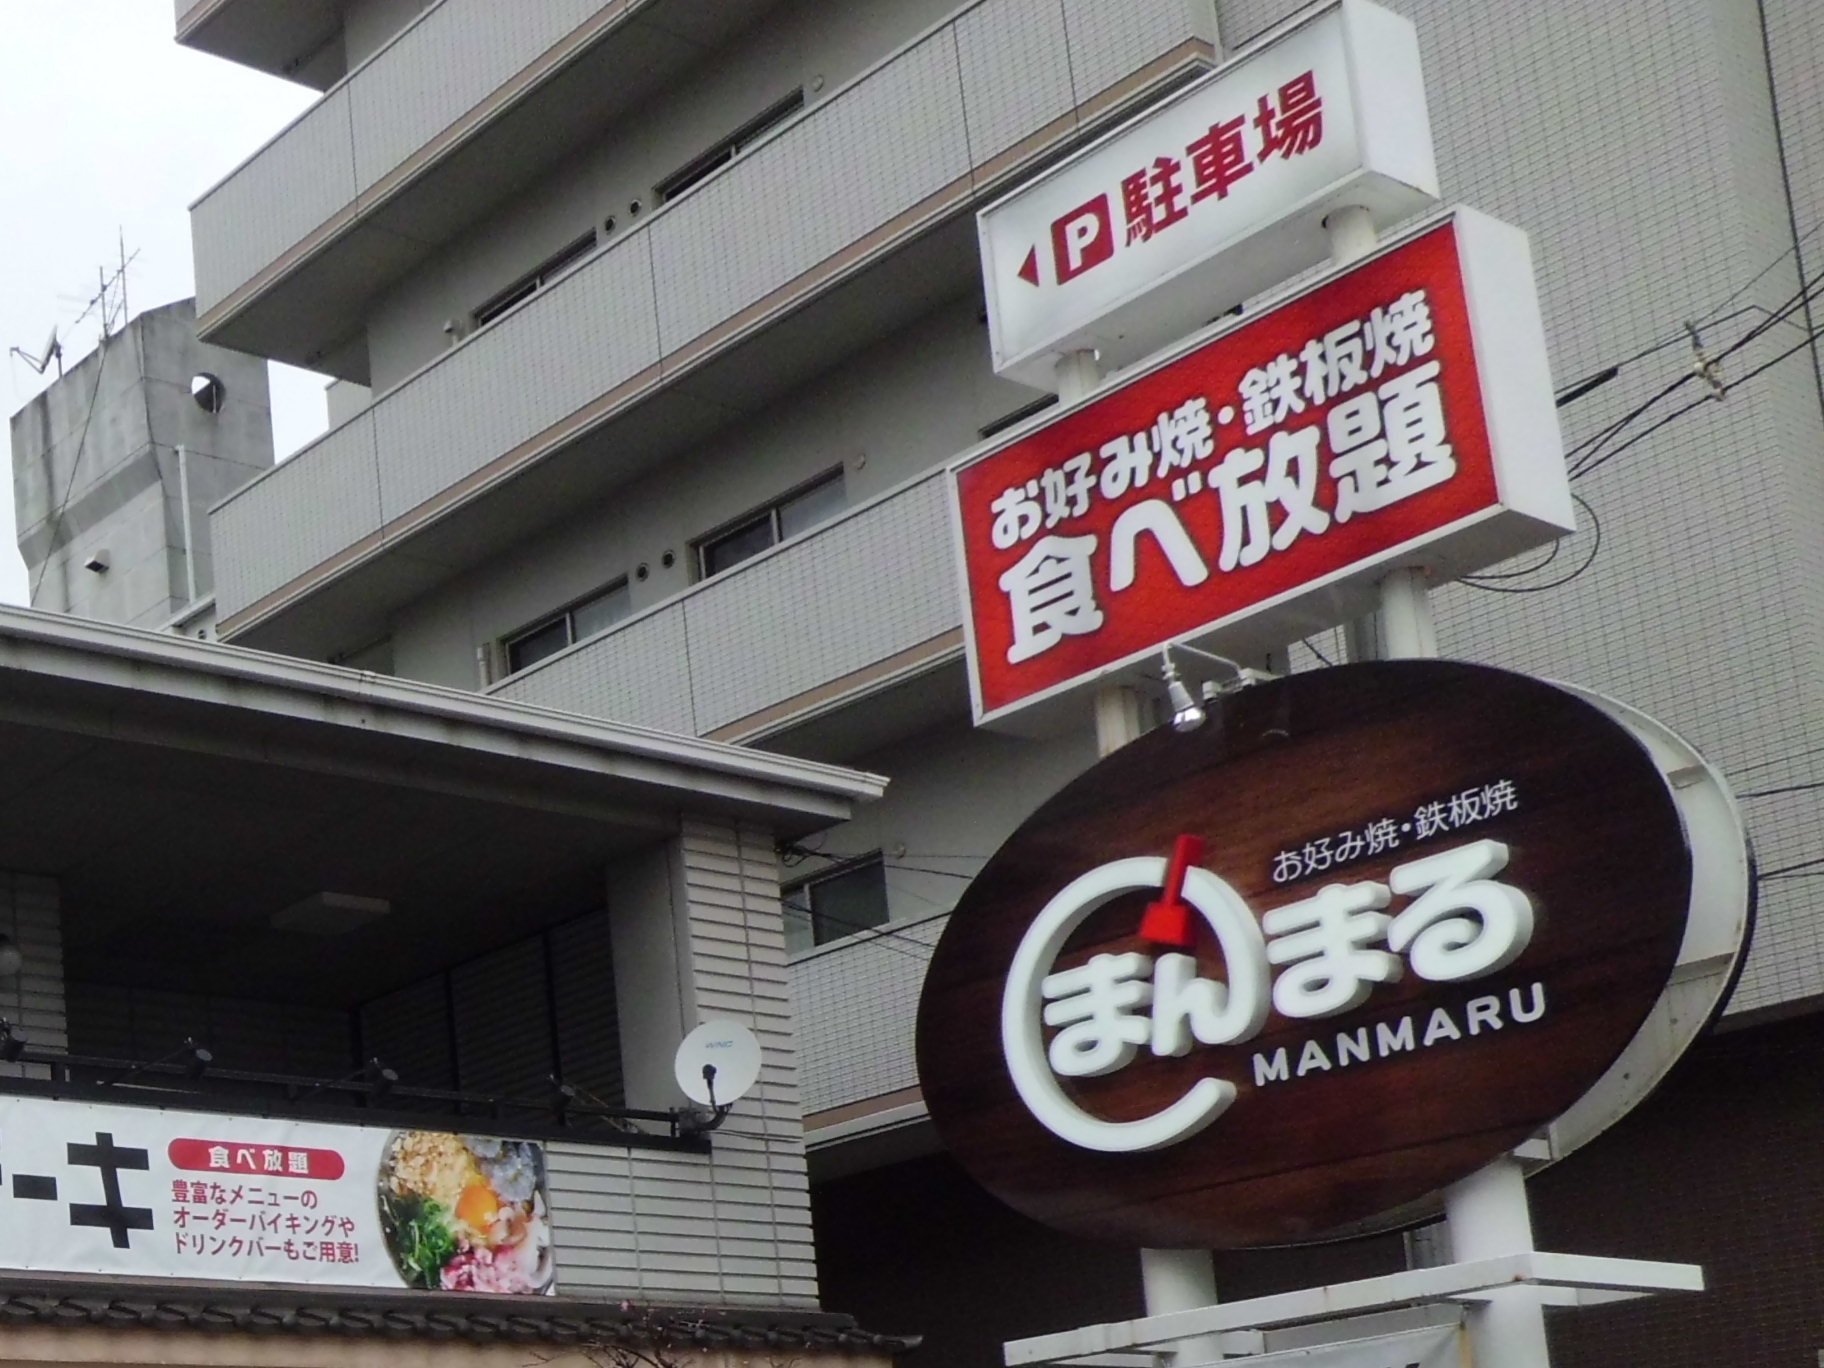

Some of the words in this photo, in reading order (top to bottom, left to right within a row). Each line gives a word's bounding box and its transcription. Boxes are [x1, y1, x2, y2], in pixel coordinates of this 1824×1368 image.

[1121, 70, 1323, 248] 駐車場
[990, 288, 1435, 550] お好み焼・鉄板焼
[998, 361, 1458, 664] 食べ放題
[1271, 779, 1518, 884] お好み焼・鉄板焼
[1001, 838, 1535, 1152] まんまる
[1252, 982, 1546, 1087] MANMARU
[171, 1179, 318, 1210] 豊富なメニューの
[208, 1145, 310, 1175] 食べ放題
[173, 1206, 355, 1238] オーダーバイキングや
